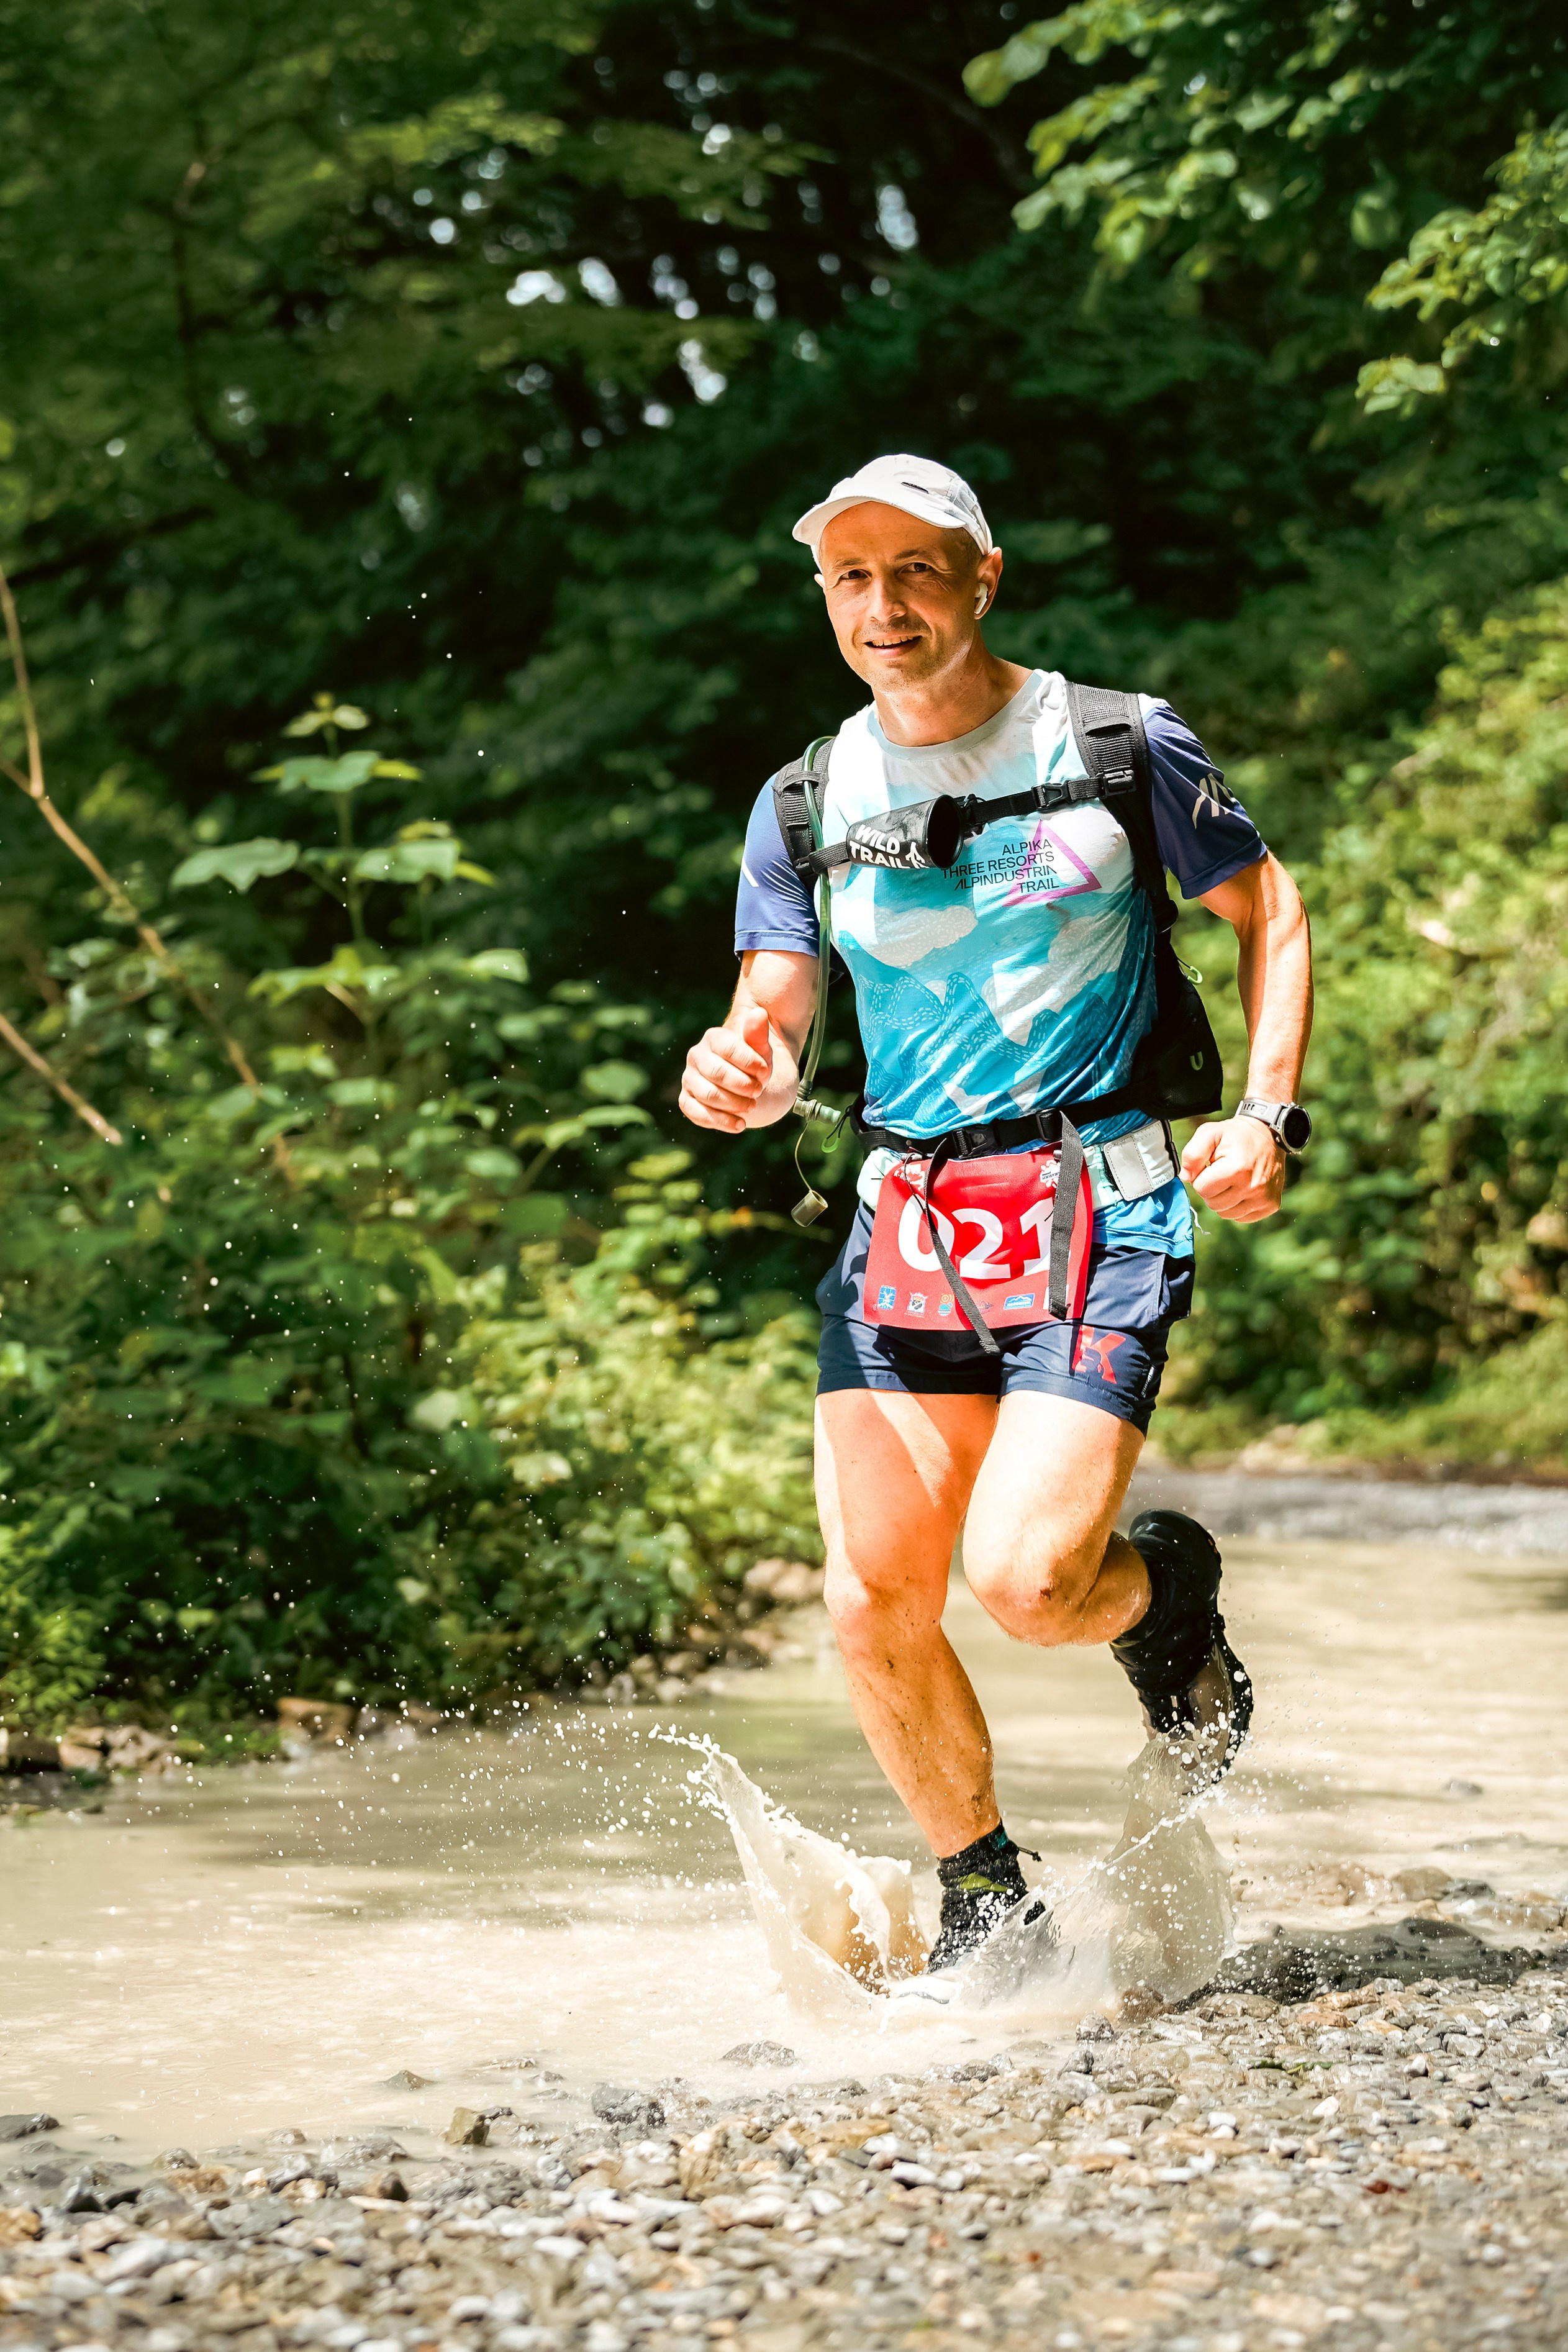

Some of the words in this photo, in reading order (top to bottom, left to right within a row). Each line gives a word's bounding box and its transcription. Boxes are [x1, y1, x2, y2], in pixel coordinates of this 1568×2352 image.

[854, 824, 900, 855] WILD
[1002, 838, 1052, 855] ALPIKA
[849, 840, 911, 869] TRAIL
[940, 861, 985, 879] THREE
[988, 851, 1054, 871] RESORTS
[1017, 878, 1059, 894] TRAIL
[898, 1193, 1071, 1279] 021
